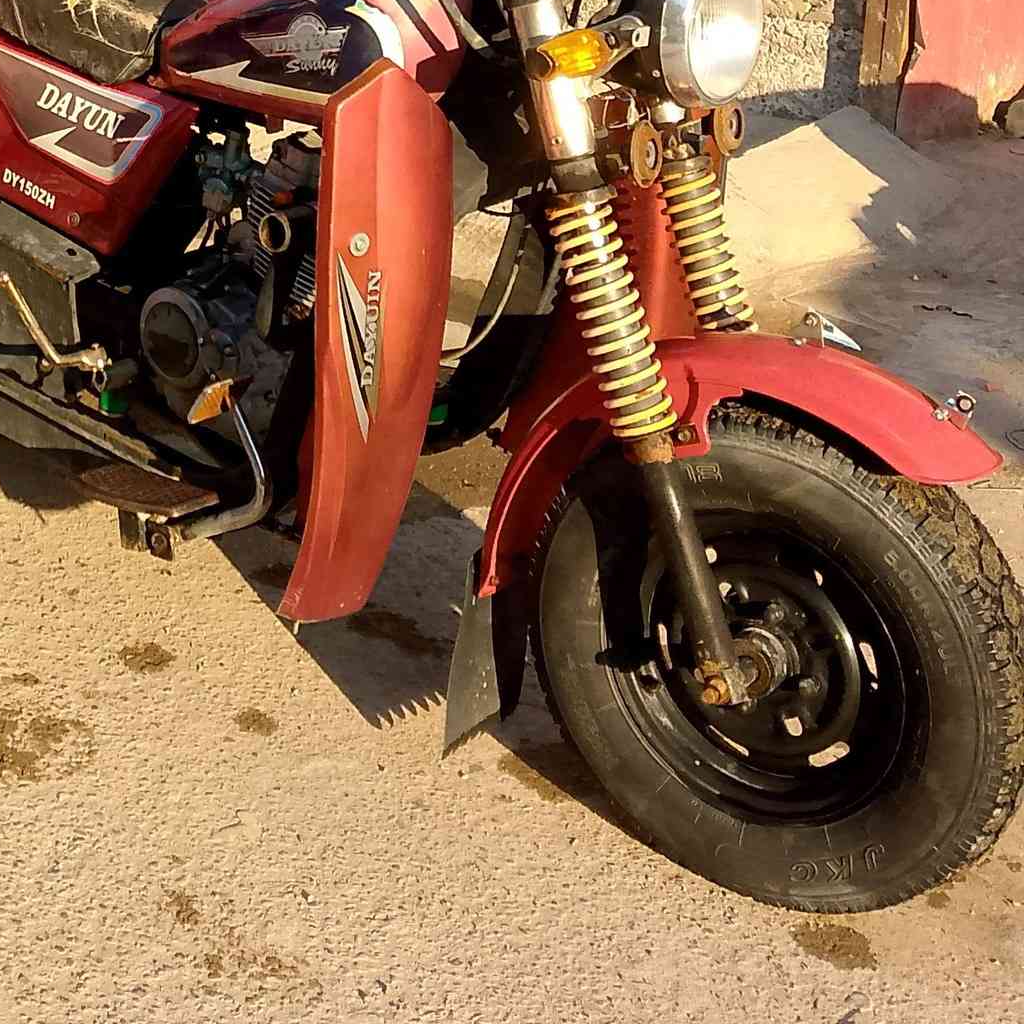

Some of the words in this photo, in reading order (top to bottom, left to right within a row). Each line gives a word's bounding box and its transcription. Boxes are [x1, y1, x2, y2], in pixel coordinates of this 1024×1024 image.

[36, 83, 125, 139] DAYUN
[3, 168, 56, 209] DY150ZH
[360, 270, 381, 388] DAYUN
